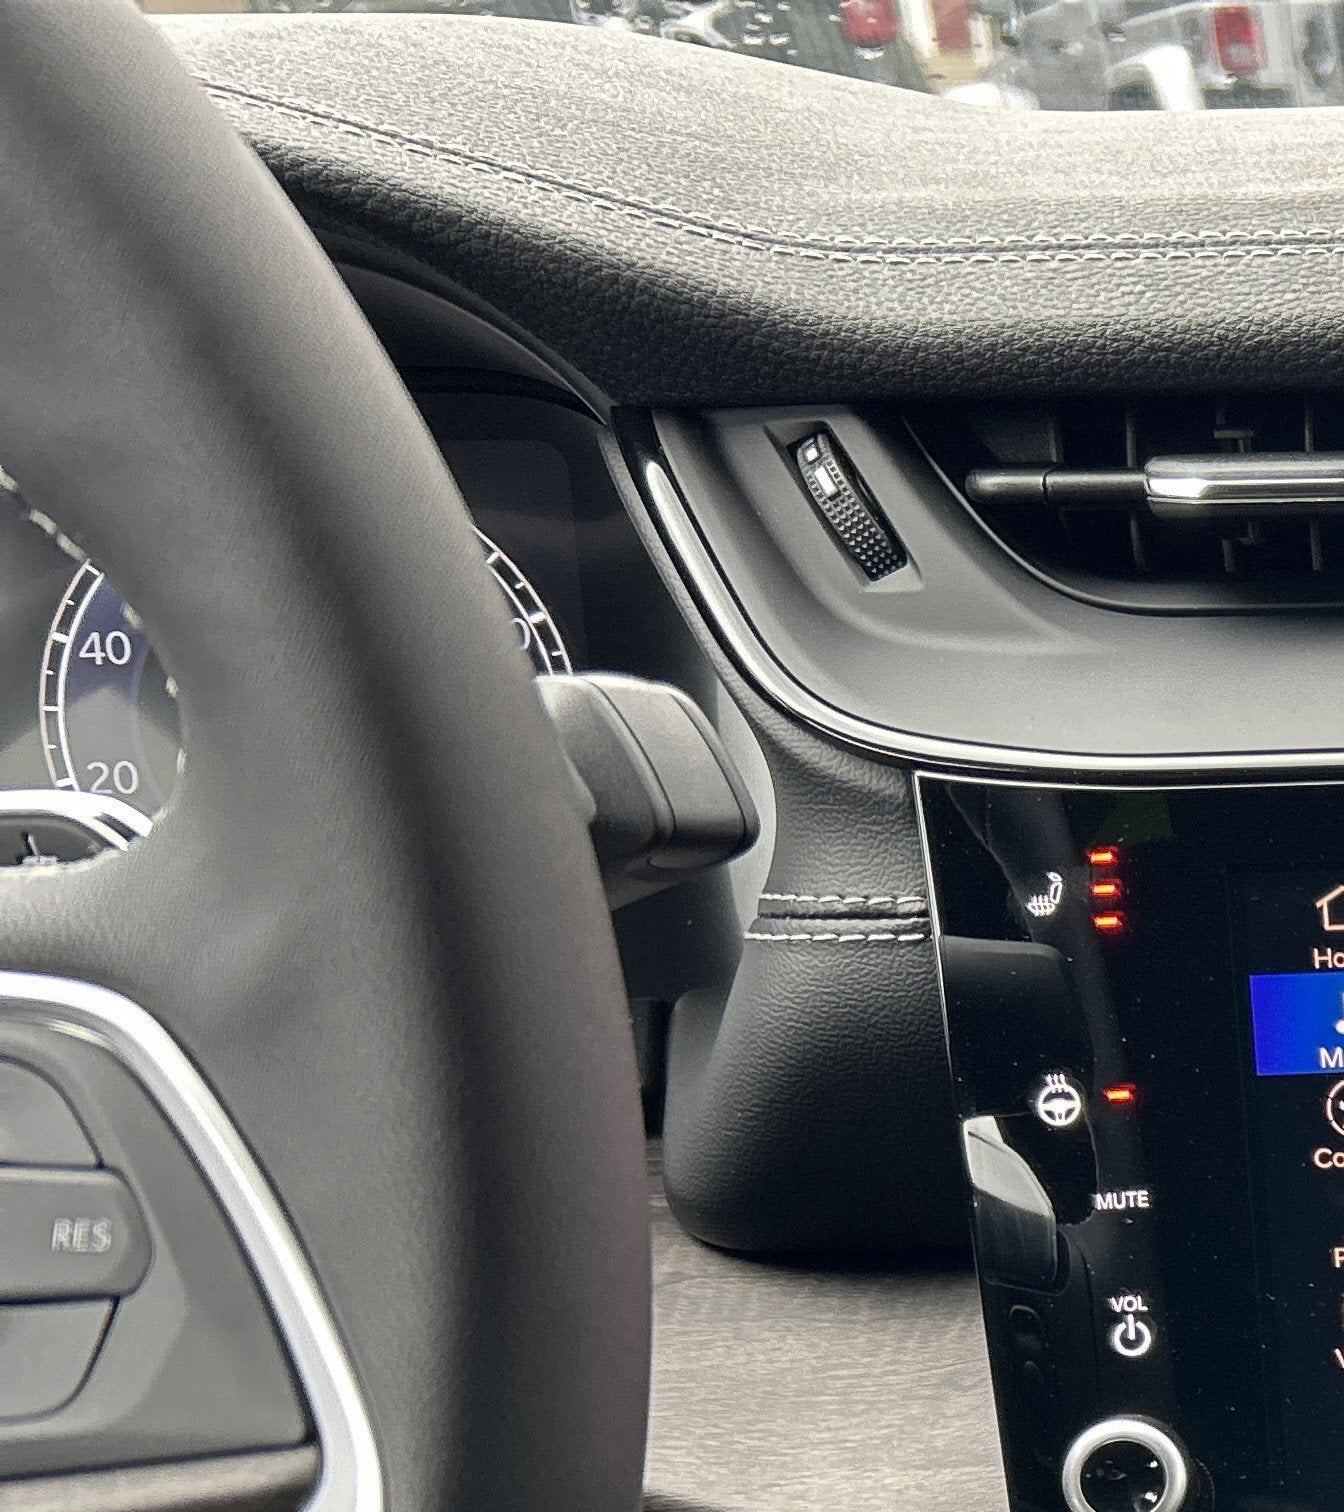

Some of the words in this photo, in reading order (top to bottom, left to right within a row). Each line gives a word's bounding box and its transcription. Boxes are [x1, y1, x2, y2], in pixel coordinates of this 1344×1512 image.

[79, 631, 131, 665] 40
[86, 760, 138, 794] 20
[1095, 1190, 1150, 1211] MUTE
[51, 1218, 113, 1253] RES
[1111, 1296, 1148, 1313] VOL
